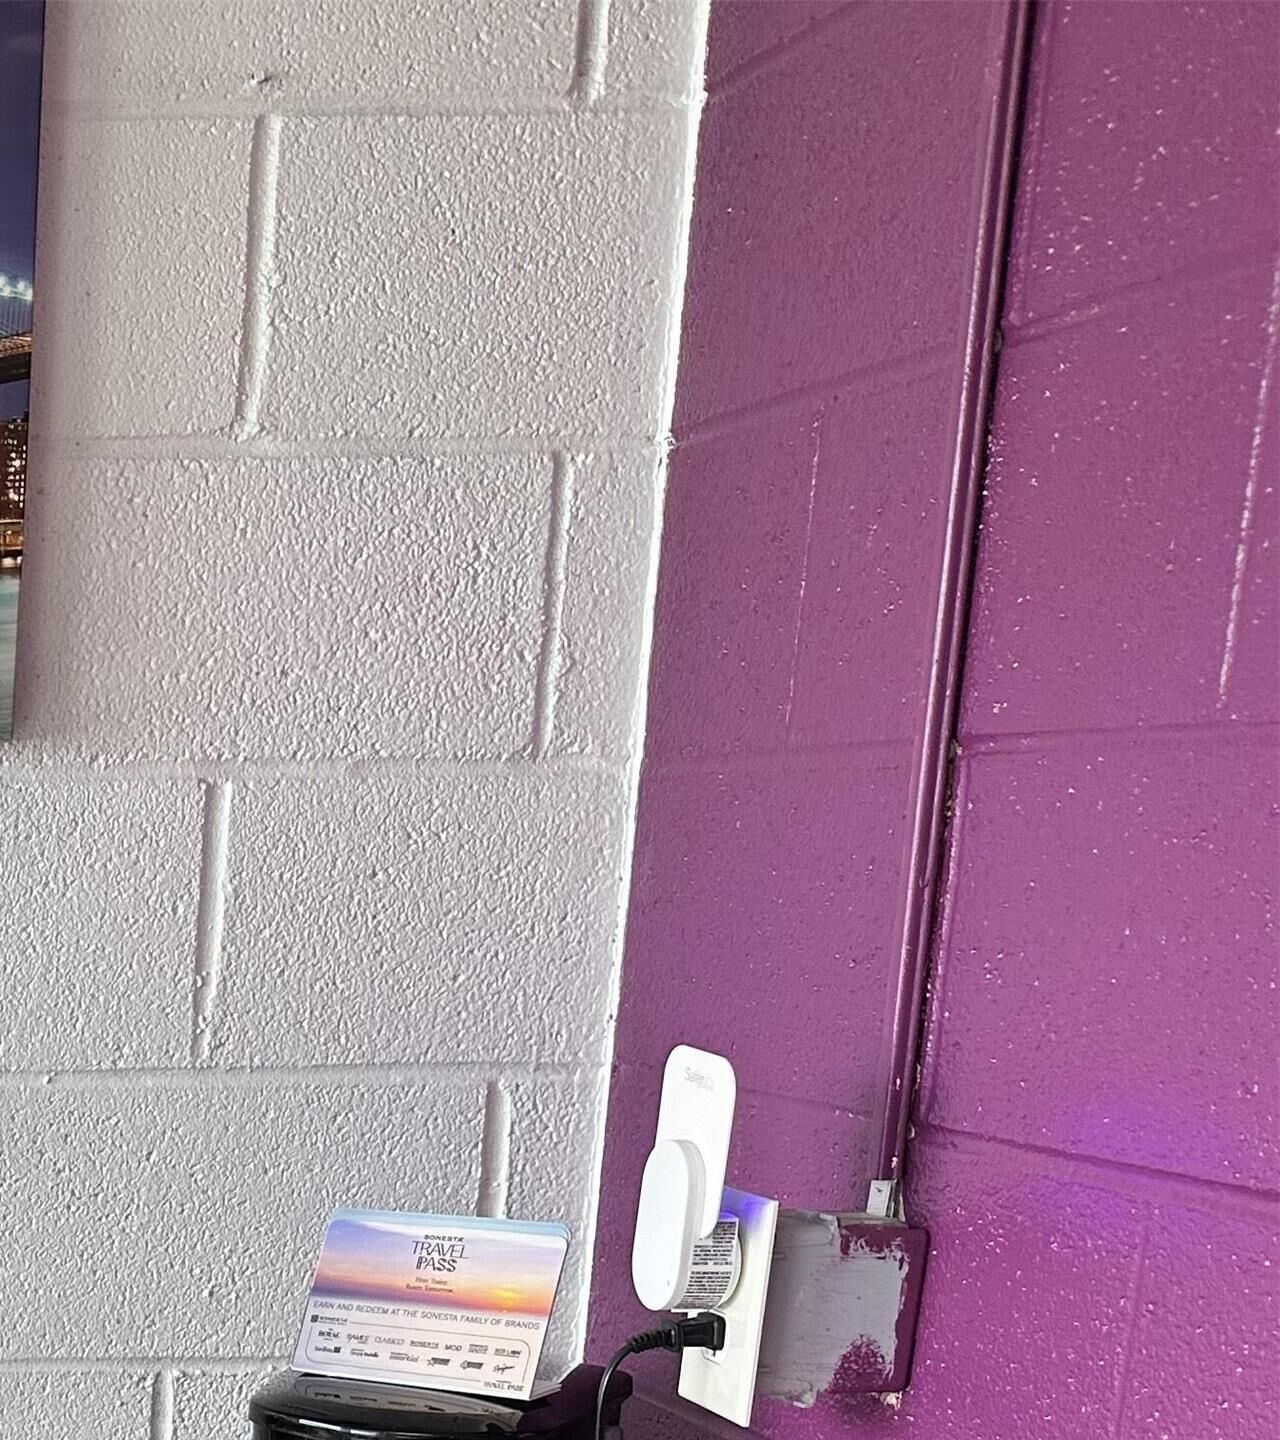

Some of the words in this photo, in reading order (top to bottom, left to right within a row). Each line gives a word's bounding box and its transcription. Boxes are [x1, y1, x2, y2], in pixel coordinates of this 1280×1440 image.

[412, 1240, 469, 1259] TRAVEL
[416, 1255, 458, 1272] PASS
[313, 1300, 335, 1310] EARN
[336, 1302, 354, 1312] AND
[355, 1304, 389, 1316] REDEEM
[391, 1307, 402, 1316] AT
[403, 1308, 418, 1318] THE
[419, 1310, 458, 1322] SONESTA
[460, 1314, 489, 1325] FAMILY
[490, 1317, 502, 1326] OF
[504, 1319, 540, 1330] BRANDS
